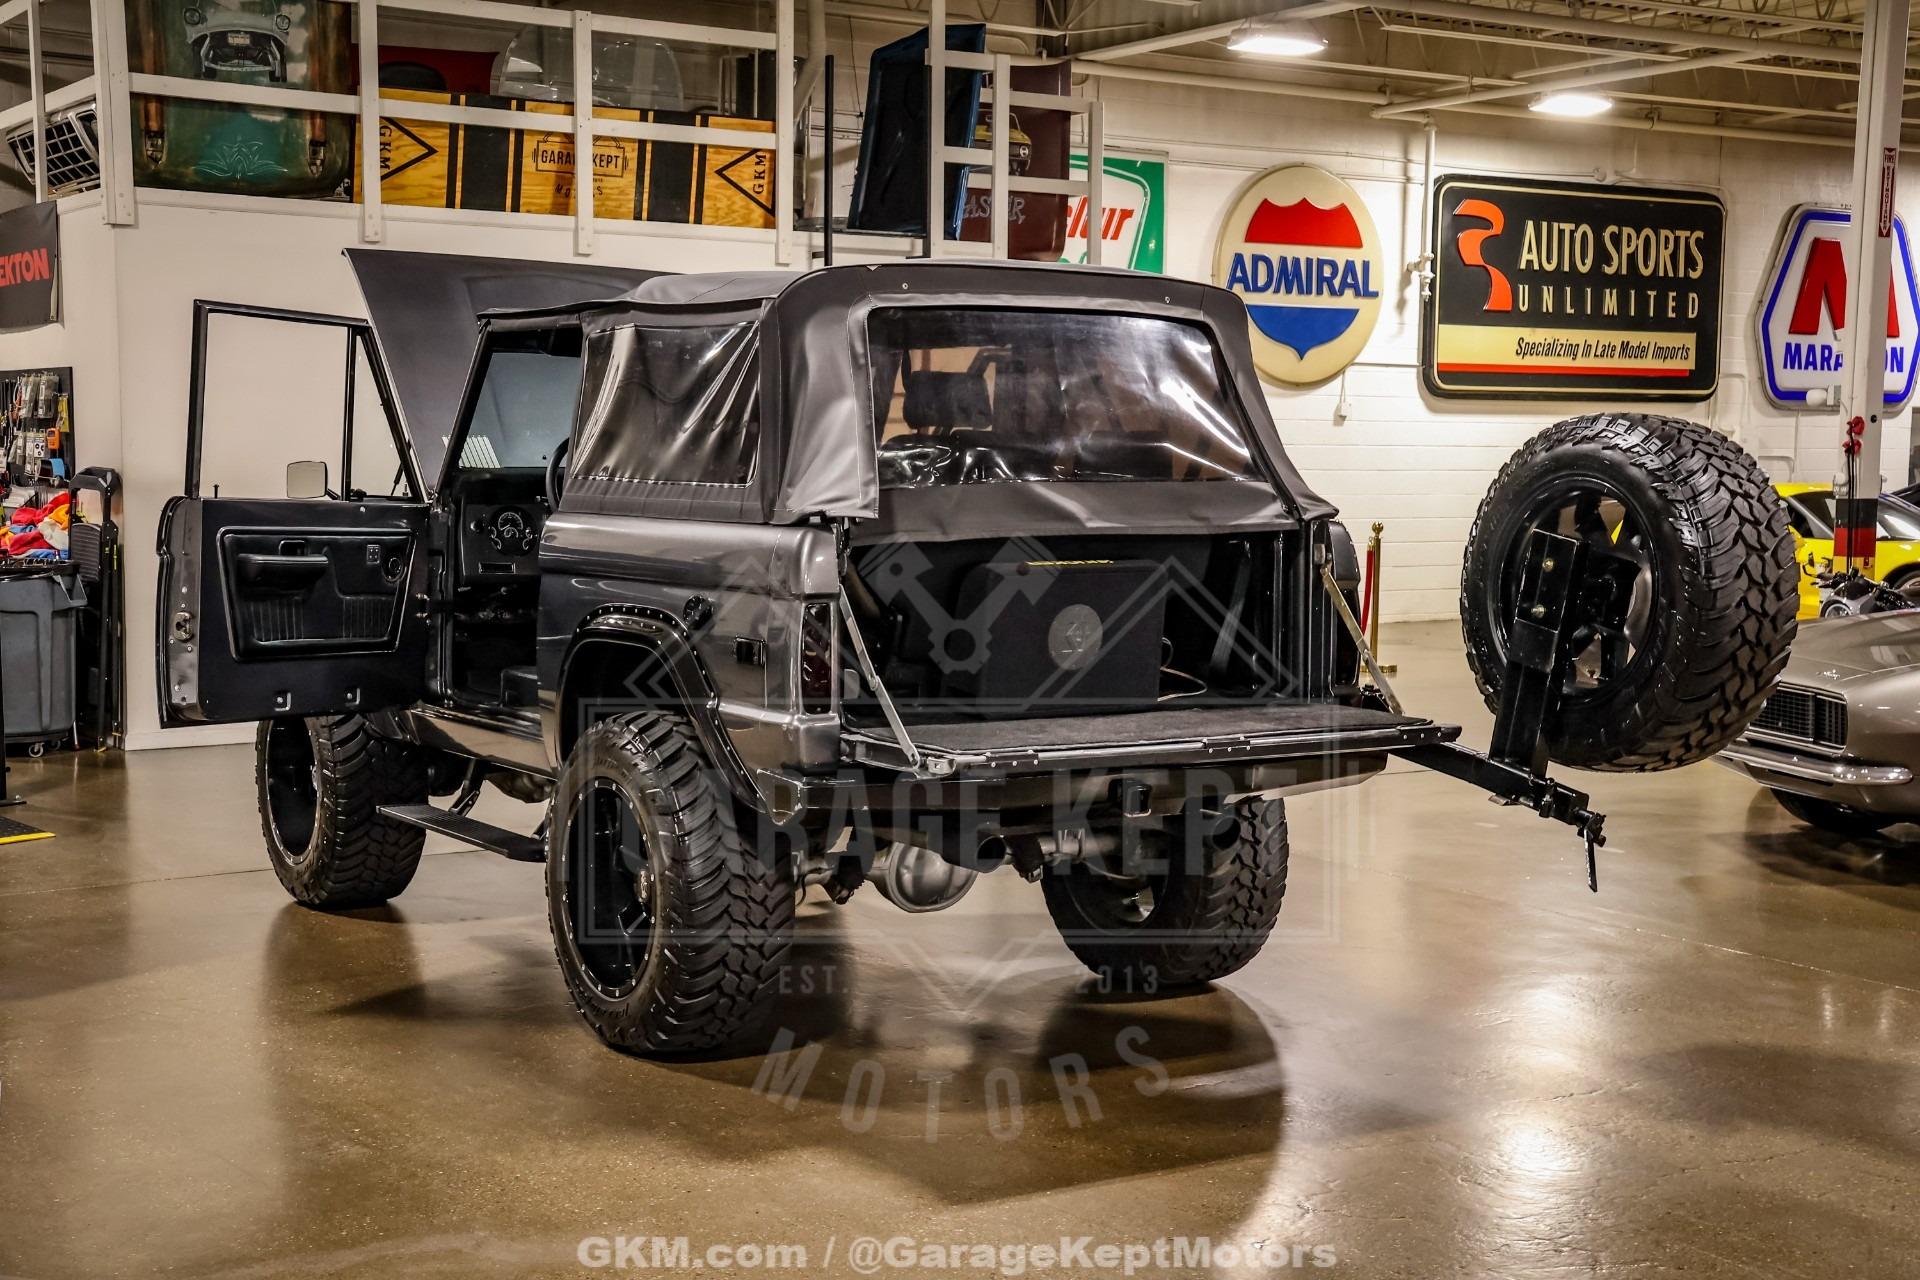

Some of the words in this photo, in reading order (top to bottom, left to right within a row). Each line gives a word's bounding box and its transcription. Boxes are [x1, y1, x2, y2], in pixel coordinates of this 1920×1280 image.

[379, 125, 393, 170] GKM
[541, 149, 576, 166] GARA
[555, 183, 603, 199] MOS
[752, 154, 767, 195] GKM
[1518, 219, 1595, 275] AUTO
[1602, 224, 1705, 281] SPORTS
[1226, 252, 1380, 298] ADMIRAL
[1518, 284, 1700, 320] UNLIMITED
[1515, 336, 1580, 361] Specializing
[1581, 339, 1593, 359] In
[1594, 340, 1617, 359] Late
[1618, 340, 1651, 360] Model
[1652, 341, 1691, 362] Imports
